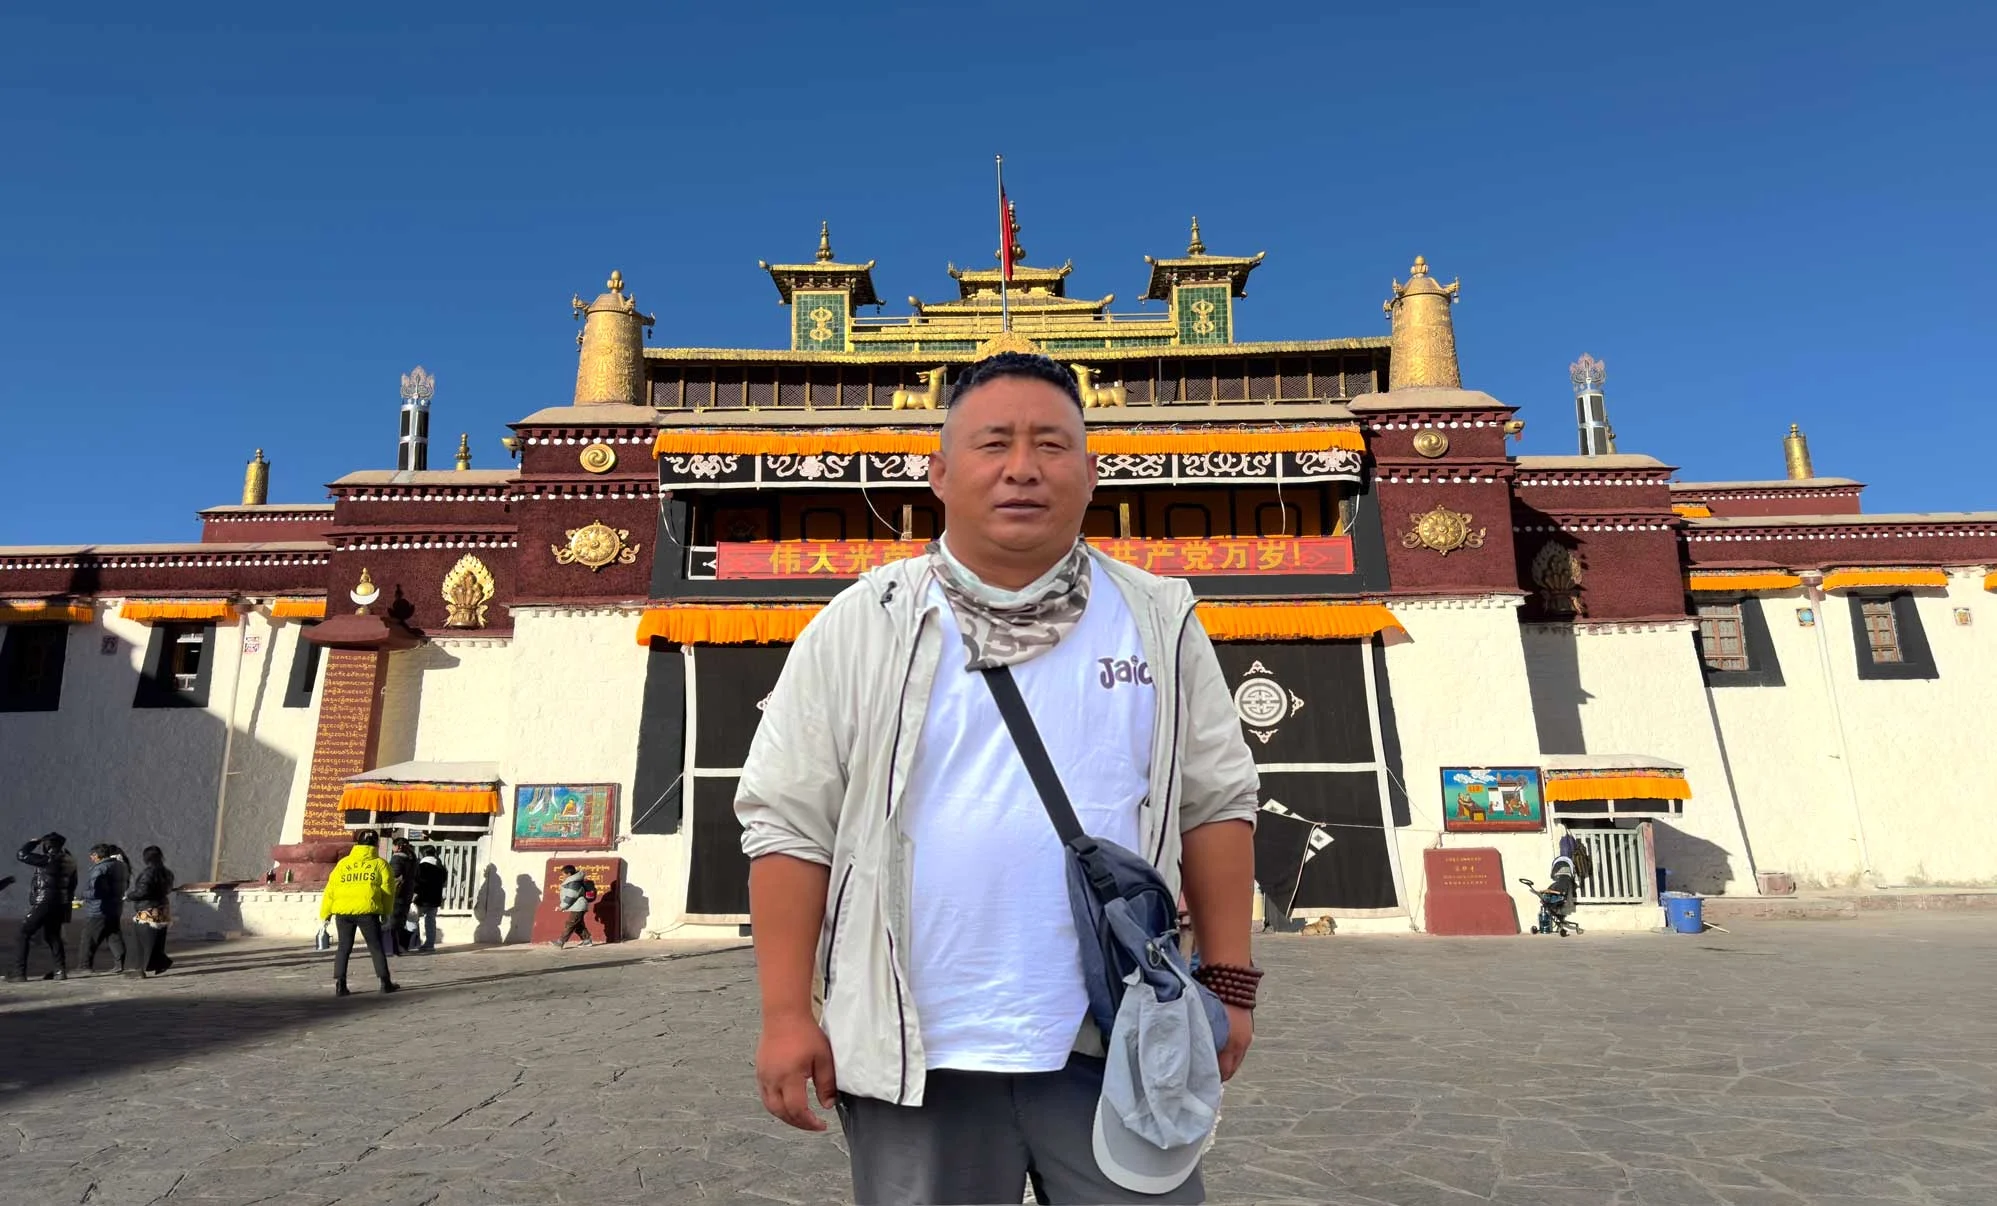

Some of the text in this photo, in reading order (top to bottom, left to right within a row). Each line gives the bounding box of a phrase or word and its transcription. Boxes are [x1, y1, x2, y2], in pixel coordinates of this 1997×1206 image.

[1087, 539, 1301, 571] 共产党万岁!
[340, 872, 376, 883] SONICS
